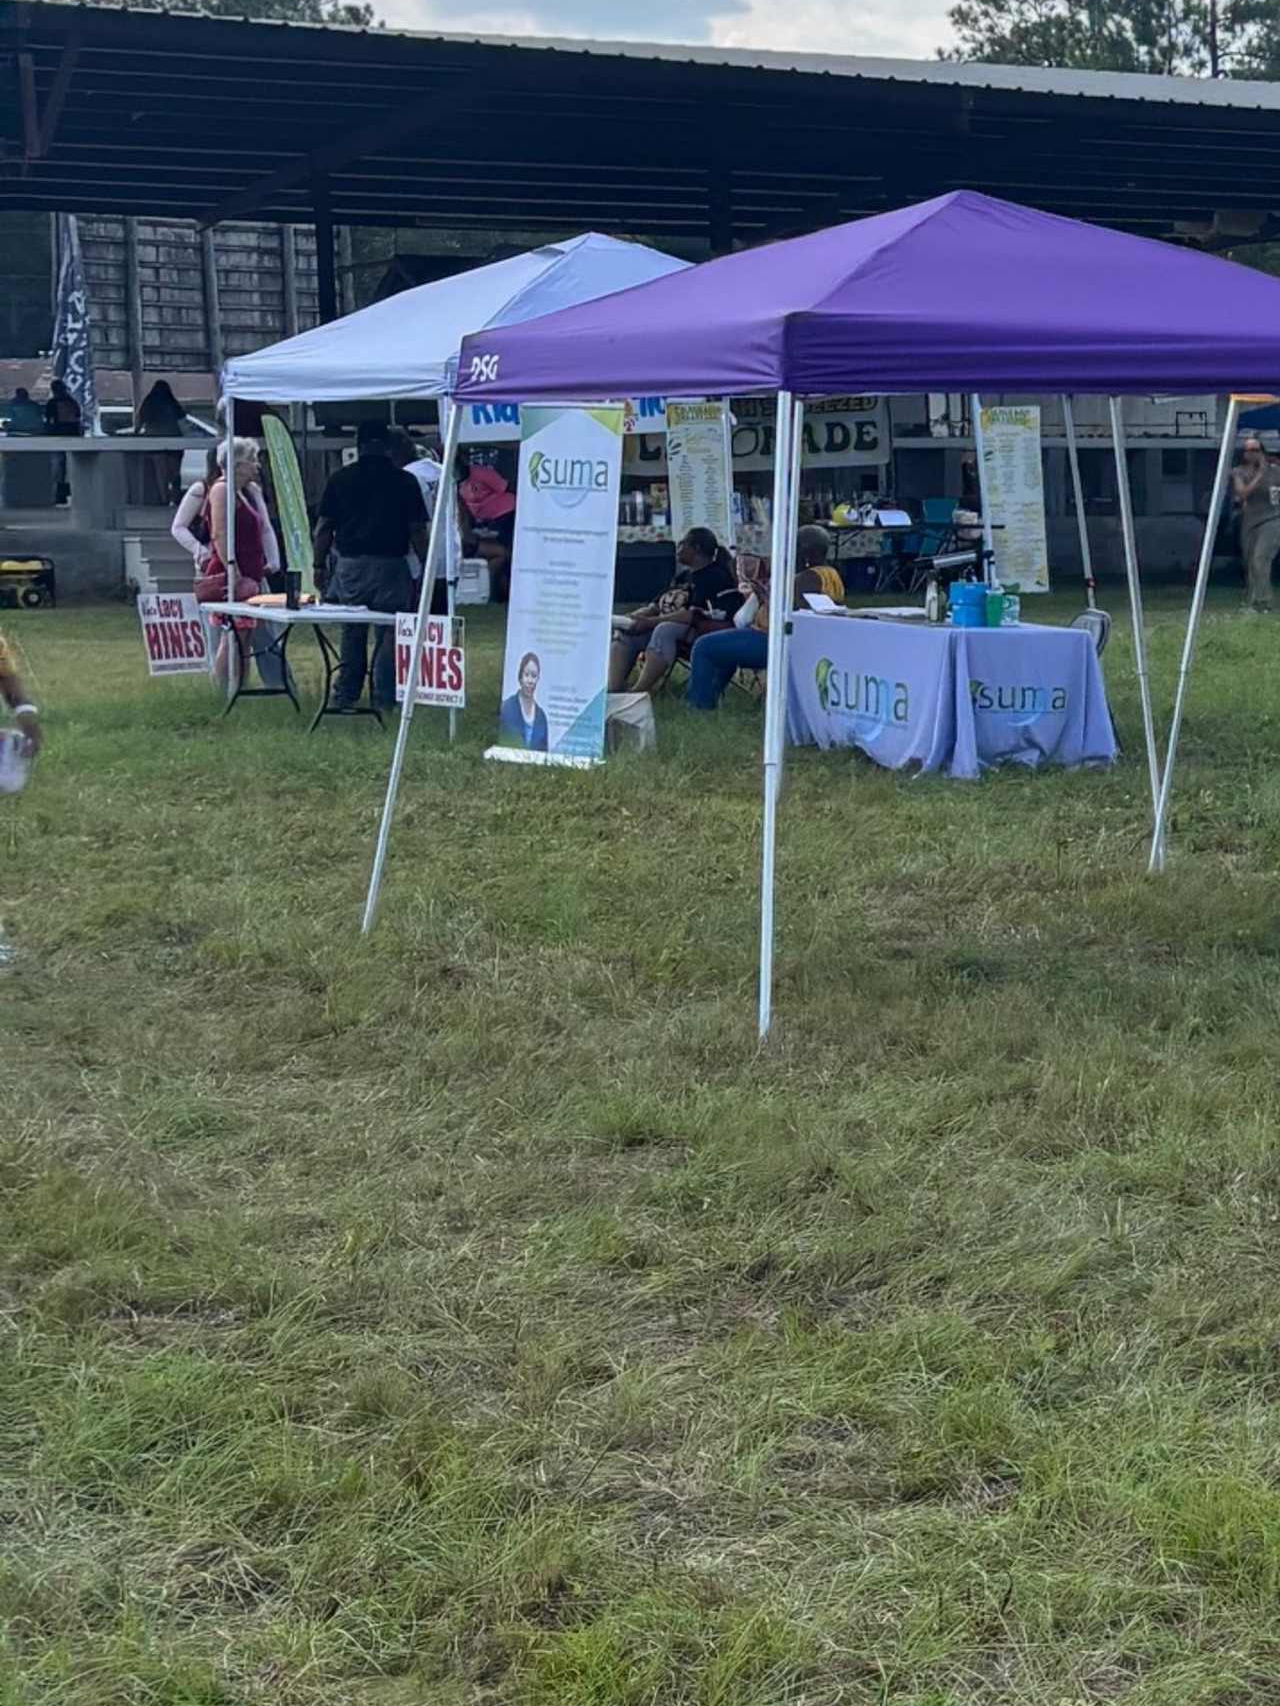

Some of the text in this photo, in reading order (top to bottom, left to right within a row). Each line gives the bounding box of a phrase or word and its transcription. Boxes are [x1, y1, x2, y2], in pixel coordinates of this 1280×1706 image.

[540, 458, 609, 487] suma
[144, 619, 206, 660] HINES
[398, 644, 463, 691] HNES
[829, 668, 909, 722] suma
[977, 685, 1066, 710] suma
